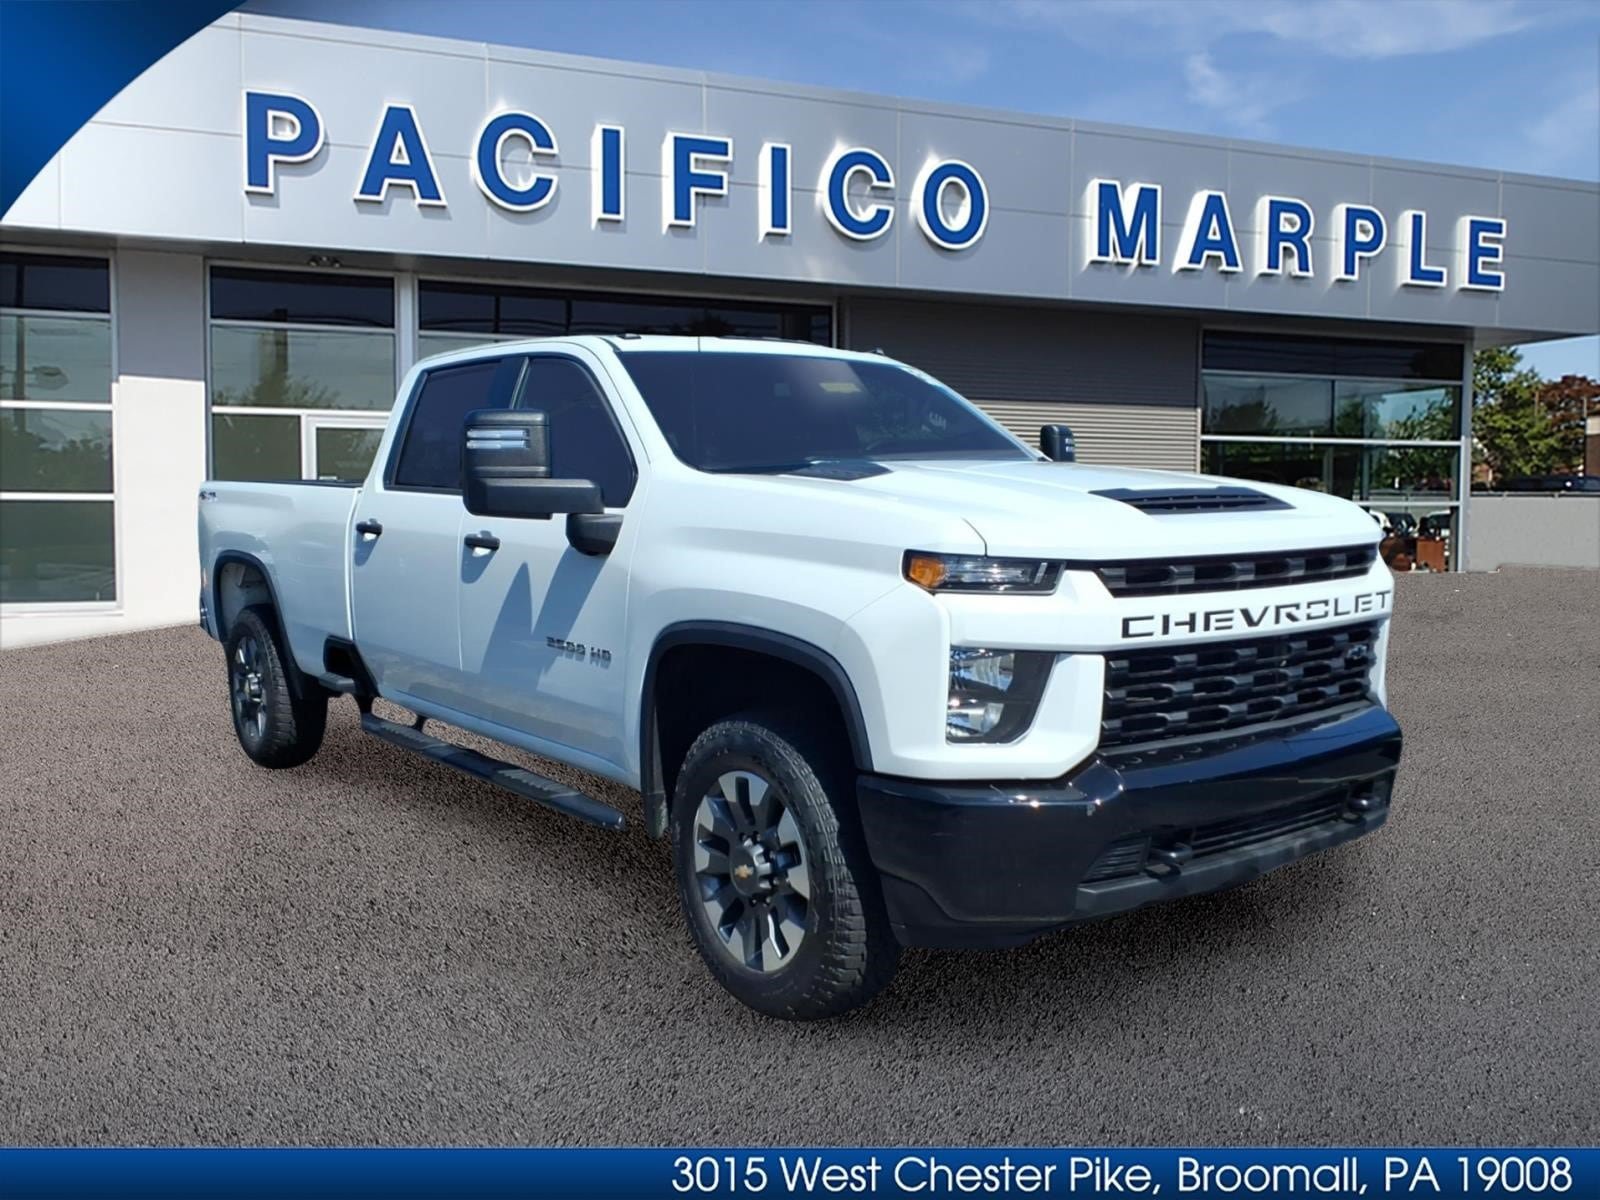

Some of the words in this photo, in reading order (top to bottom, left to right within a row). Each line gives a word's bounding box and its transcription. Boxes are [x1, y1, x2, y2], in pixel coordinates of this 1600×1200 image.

[243, 89, 989, 250] PACIFICO
[1090, 179, 1506, 291] MARPLE
[1121, 590, 1392, 639] CHEVROLET
